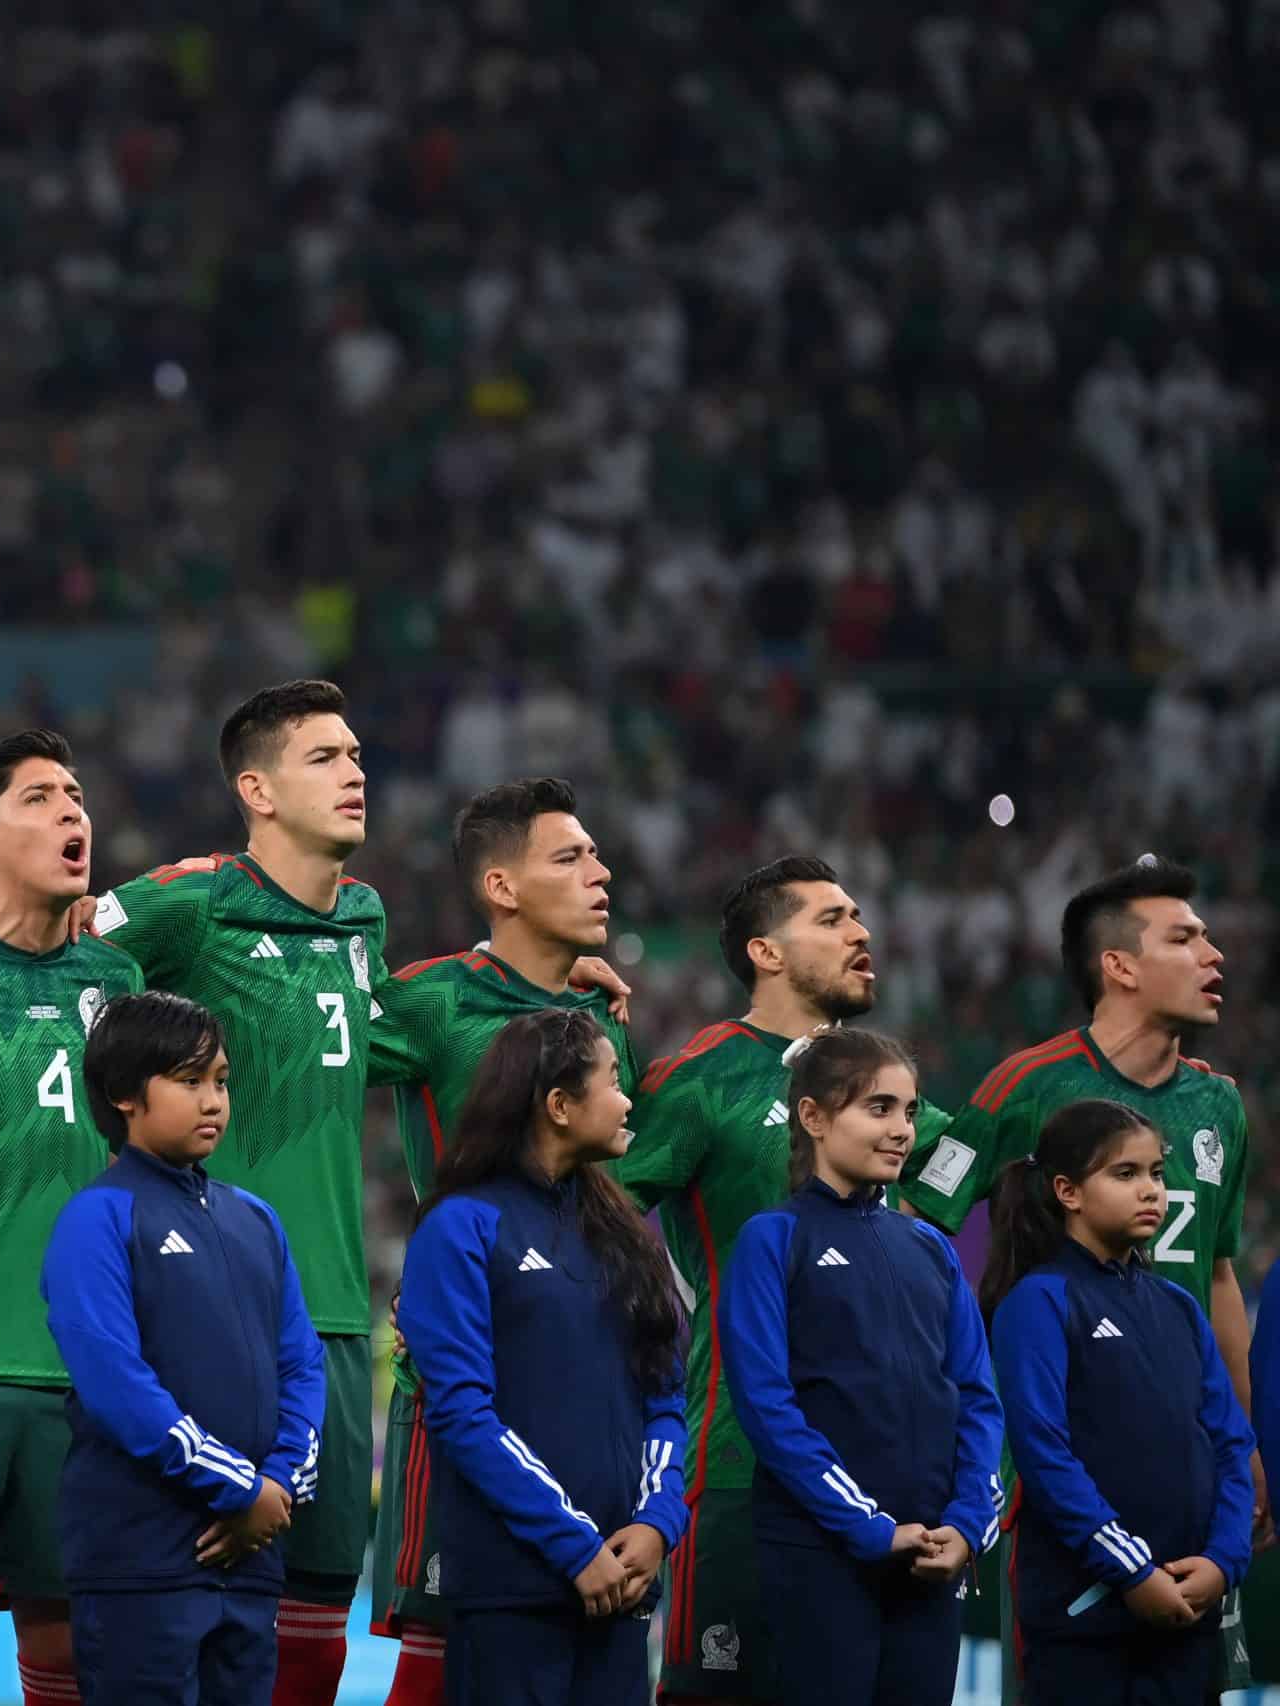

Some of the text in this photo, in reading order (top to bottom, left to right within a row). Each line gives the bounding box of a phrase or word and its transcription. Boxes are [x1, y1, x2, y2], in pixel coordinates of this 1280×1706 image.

[316, 992, 351, 1067] 3
[37, 1049, 76, 1124] 4
[1154, 1189, 1196, 1263] 2
